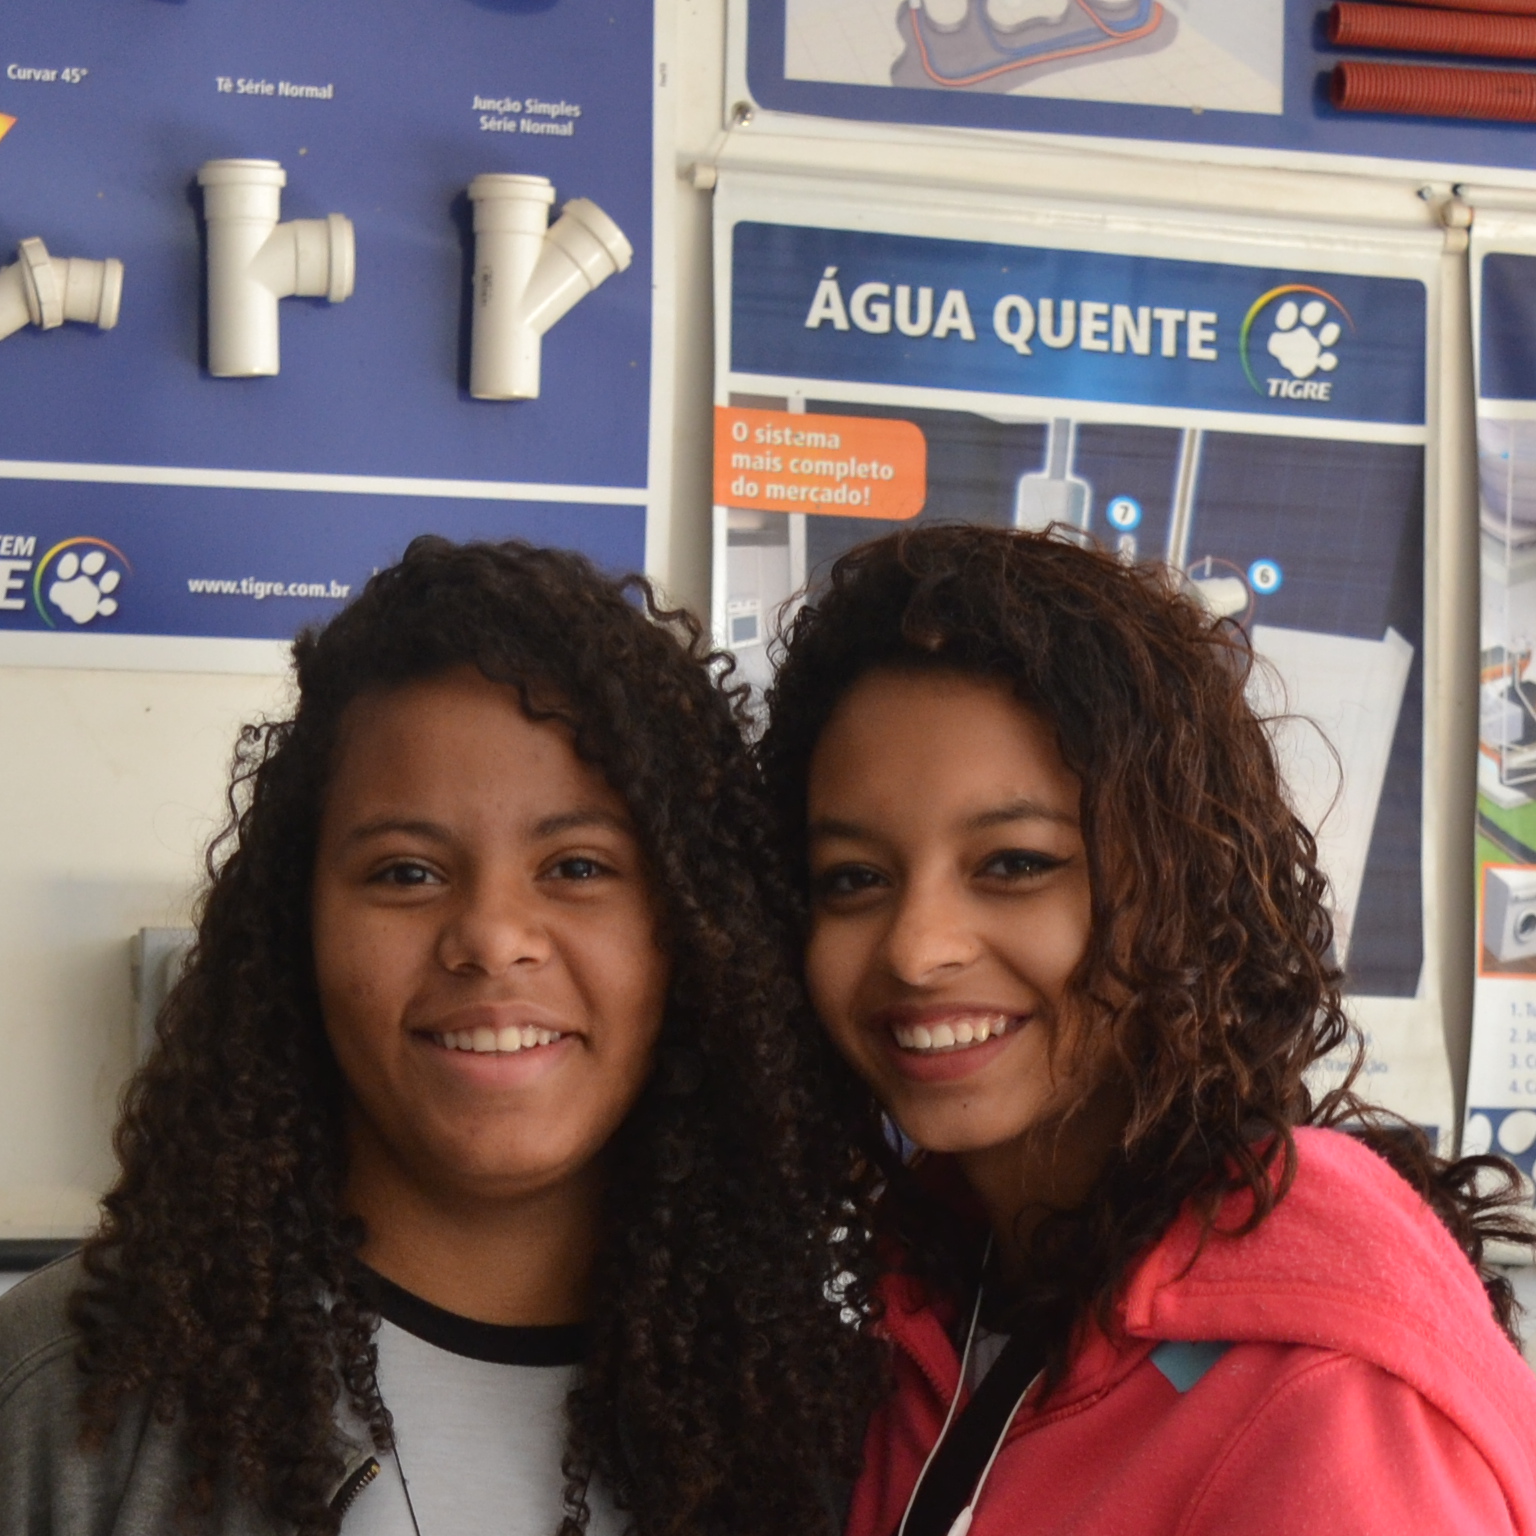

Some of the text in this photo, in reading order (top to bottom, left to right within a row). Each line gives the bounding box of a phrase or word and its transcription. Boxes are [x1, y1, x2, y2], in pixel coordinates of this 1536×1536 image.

[7, 64, 57, 83] Curvar
[278, 82, 333, 100] Normal
[525, 98, 582, 119] Simples
[520, 118, 574, 137] Normal
[805, 265, 1218, 362] ÁGUA QUENTE
[1266, 378, 1332, 401] TIGRE
[731, 421, 841, 450] O sistema
[731, 451, 894, 483] mais completo
[731, 476, 872, 507] do mercado!
[1118, 504, 1132, 523] 7
[1258, 567, 1272, 584] 6
[188, 575, 351, 600] www.tigre.com.br
